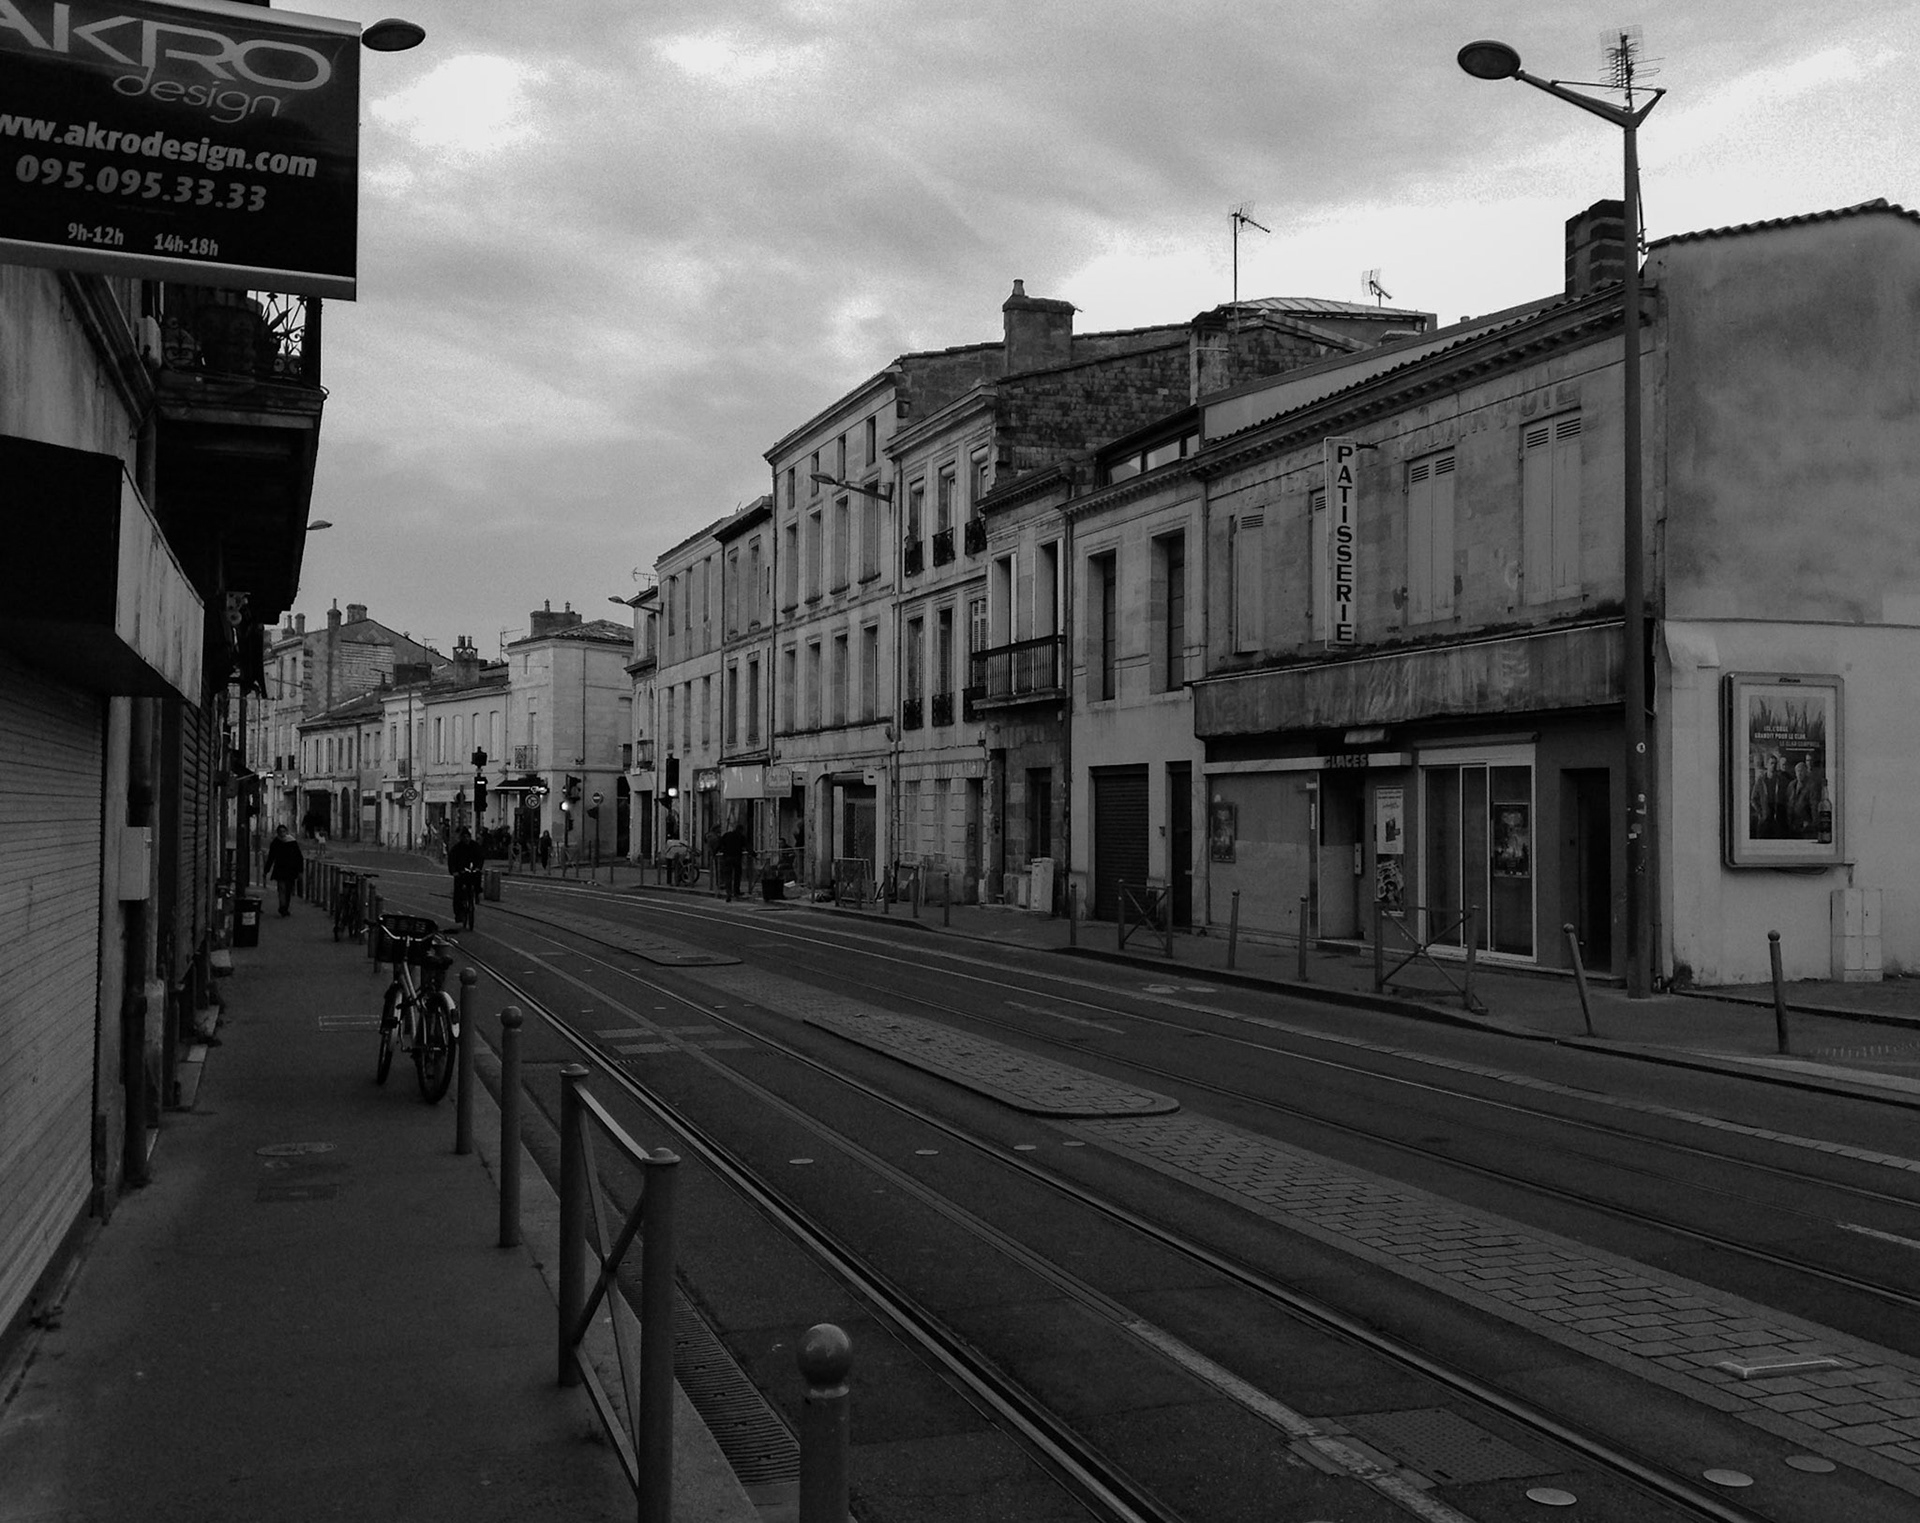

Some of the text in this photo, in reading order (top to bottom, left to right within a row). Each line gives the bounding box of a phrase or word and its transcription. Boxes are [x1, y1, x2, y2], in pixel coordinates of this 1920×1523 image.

[112, 68, 281, 123] design
[15, 154, 267, 211] 095.095.33.33
[67, 222, 219, 256] 9h-12h 14h-18h
[1336, 446, 1353, 642] PATISSERIE
[1323, 753, 1368, 769] GLACES
